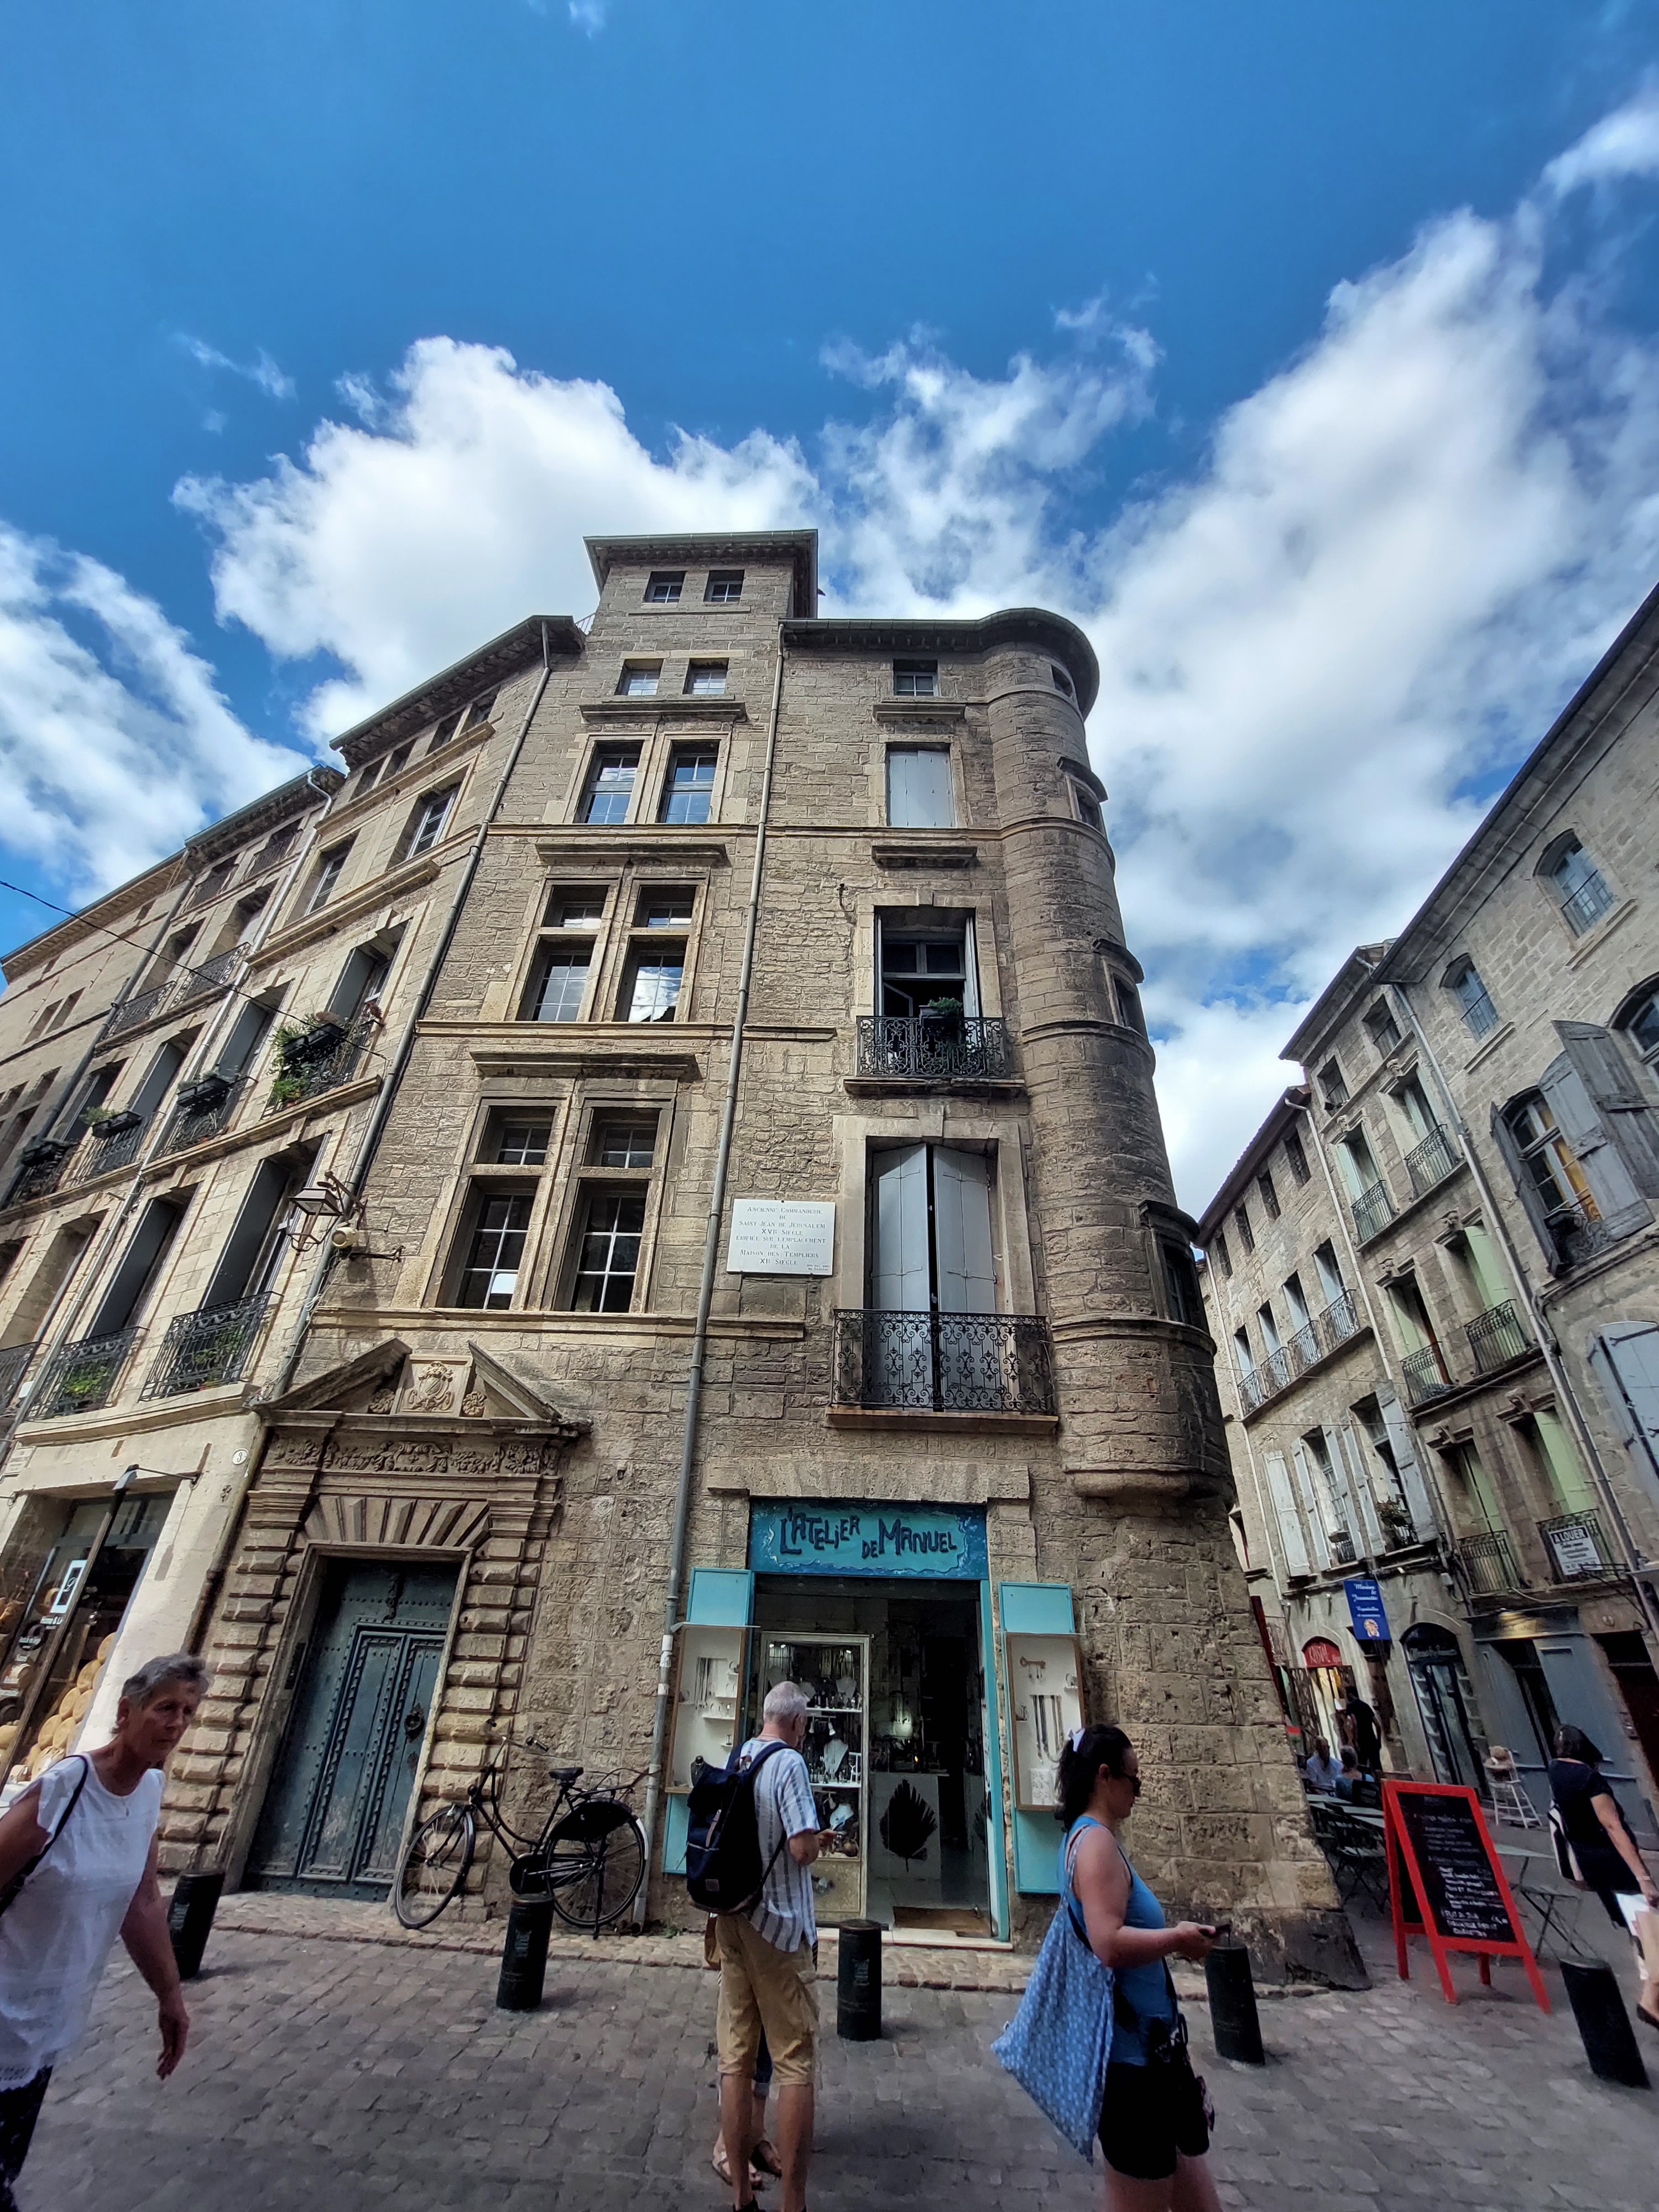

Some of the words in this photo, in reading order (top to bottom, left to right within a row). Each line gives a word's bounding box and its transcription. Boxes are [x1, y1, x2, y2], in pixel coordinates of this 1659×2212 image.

[237, 1451, 243, 1463] 3
[861, 1540, 878, 1559] DE
[878, 1518, 957, 1556] MANUEL
[1559, 1528, 1587, 1542] LOUER
